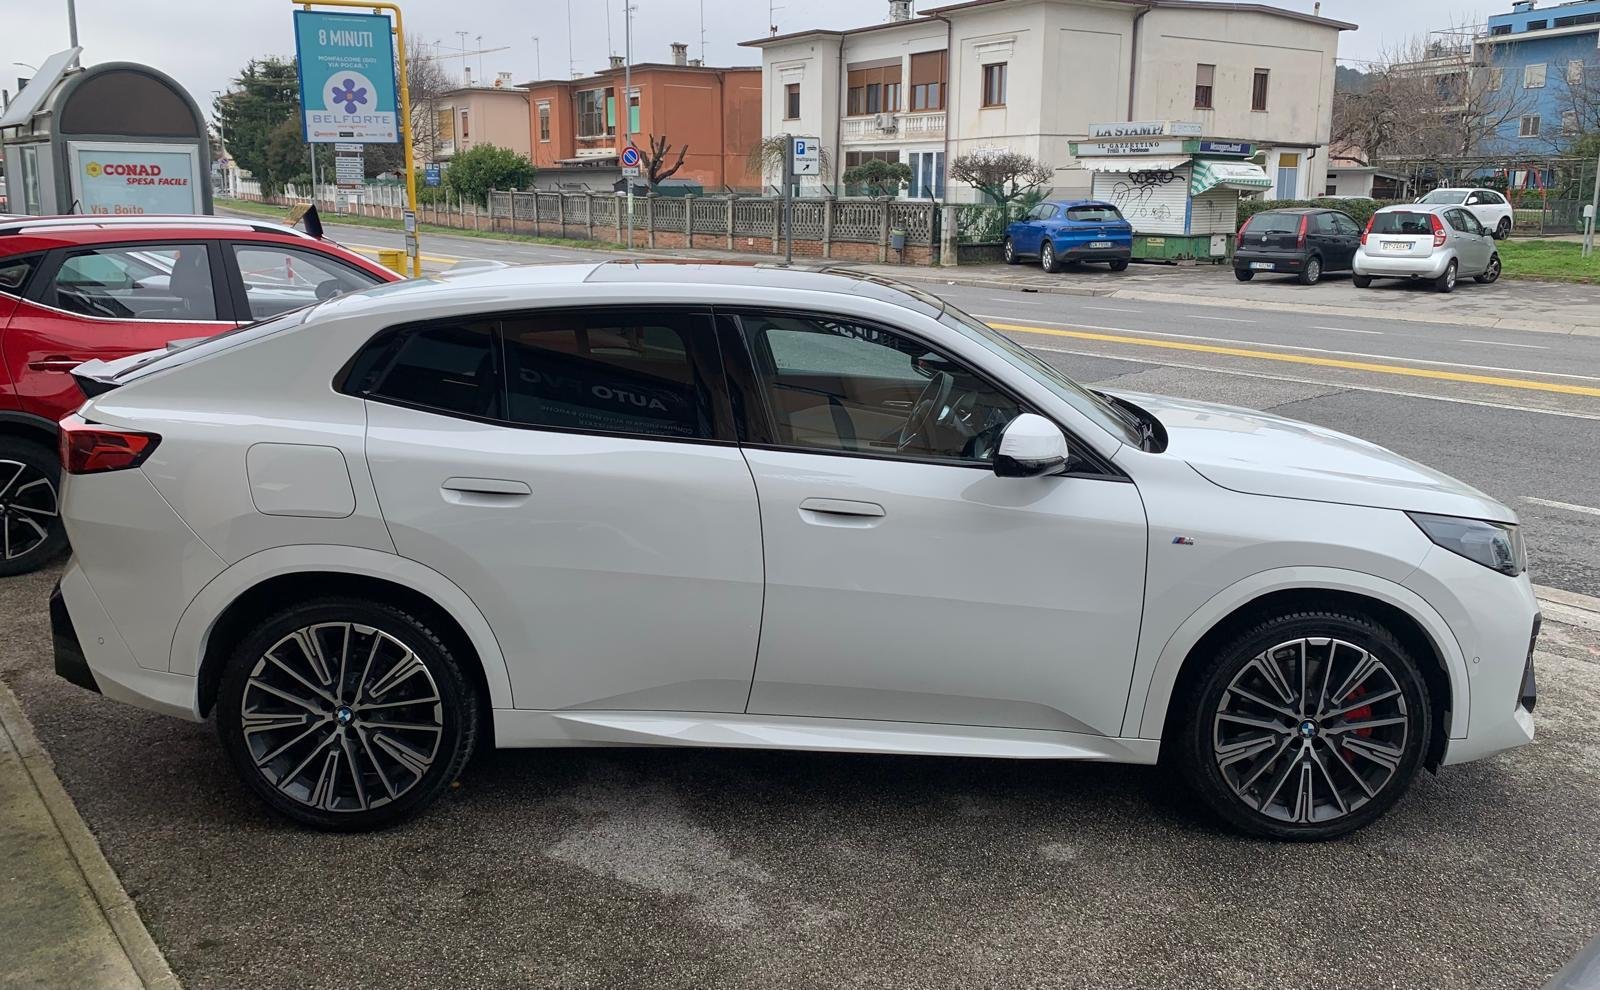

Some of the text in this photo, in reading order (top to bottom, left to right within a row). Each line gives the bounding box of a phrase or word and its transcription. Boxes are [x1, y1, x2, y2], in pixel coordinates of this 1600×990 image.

[318, 29, 373, 48] 8 MINUTI
[312, 114, 390, 125] BELFORTE
[1095, 128, 1112, 137] LA
[103, 164, 161, 176] CONAD
[127, 177, 188, 186] SPESA FACILE
[91, 204, 144, 214] Via Boito
